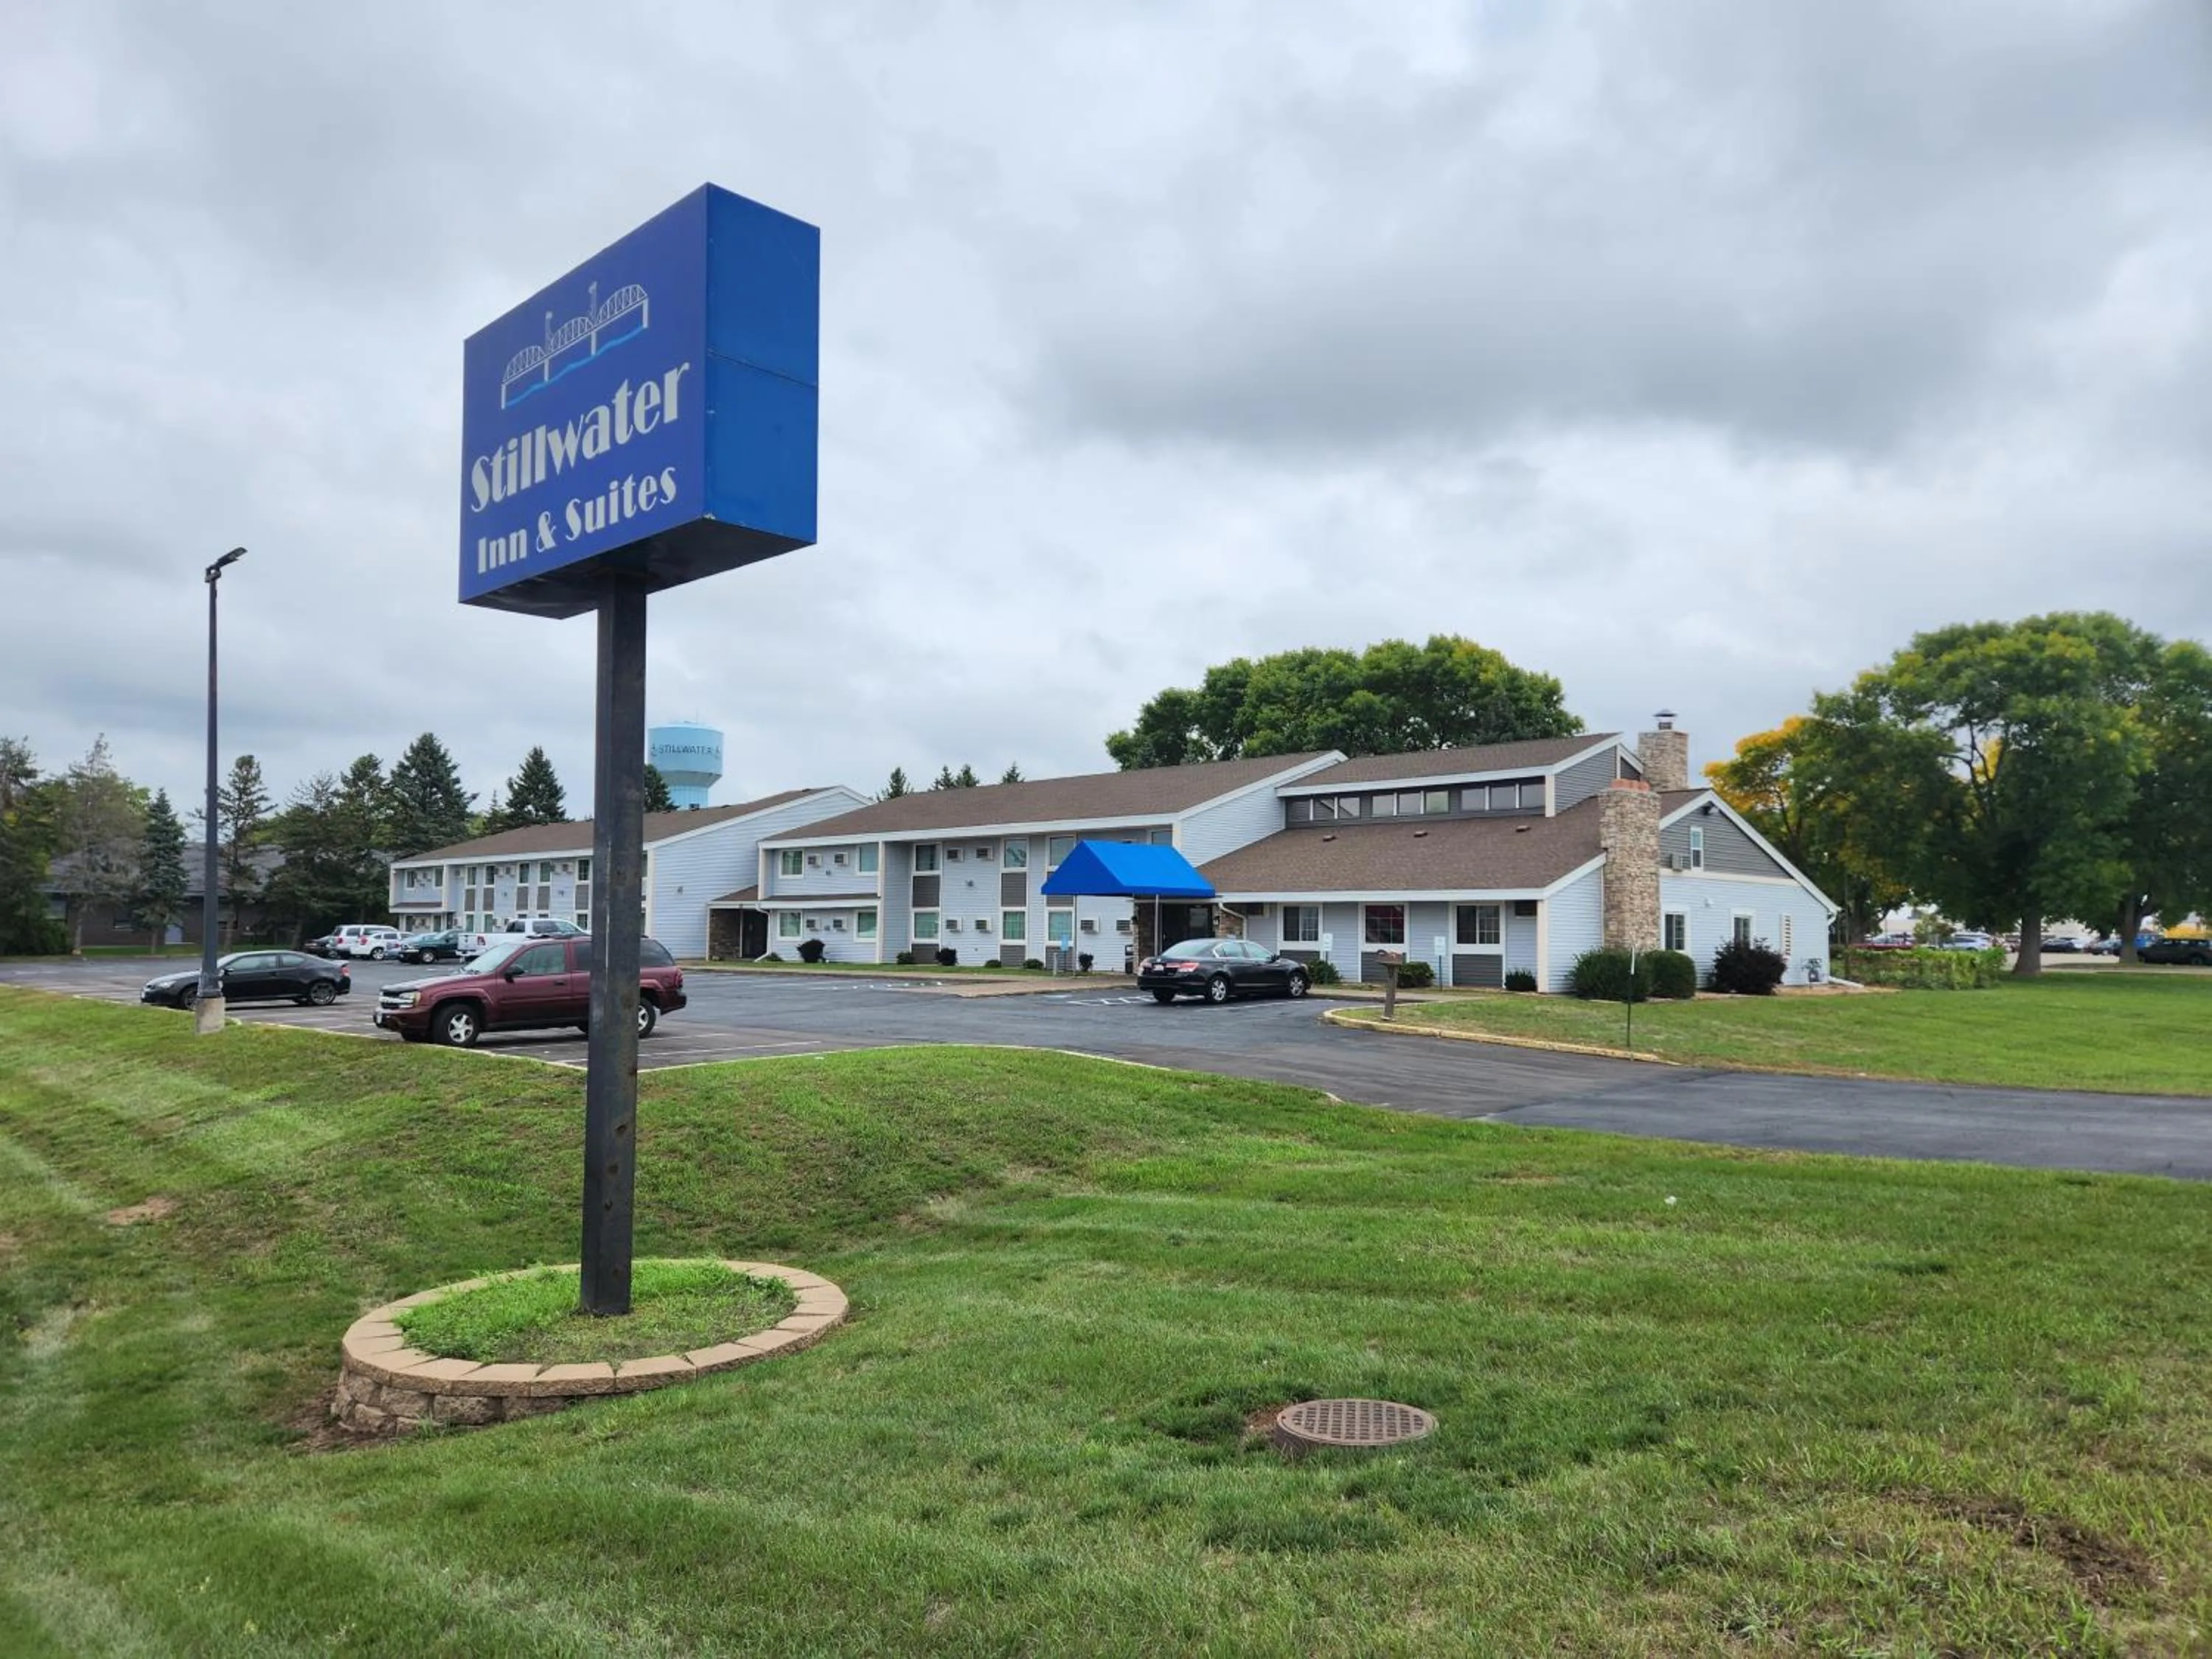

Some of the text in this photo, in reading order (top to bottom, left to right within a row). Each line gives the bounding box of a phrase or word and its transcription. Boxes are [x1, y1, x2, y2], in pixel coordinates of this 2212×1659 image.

[471, 362, 690, 512] Stillwater
[478, 467, 676, 574] Inn & Suites
